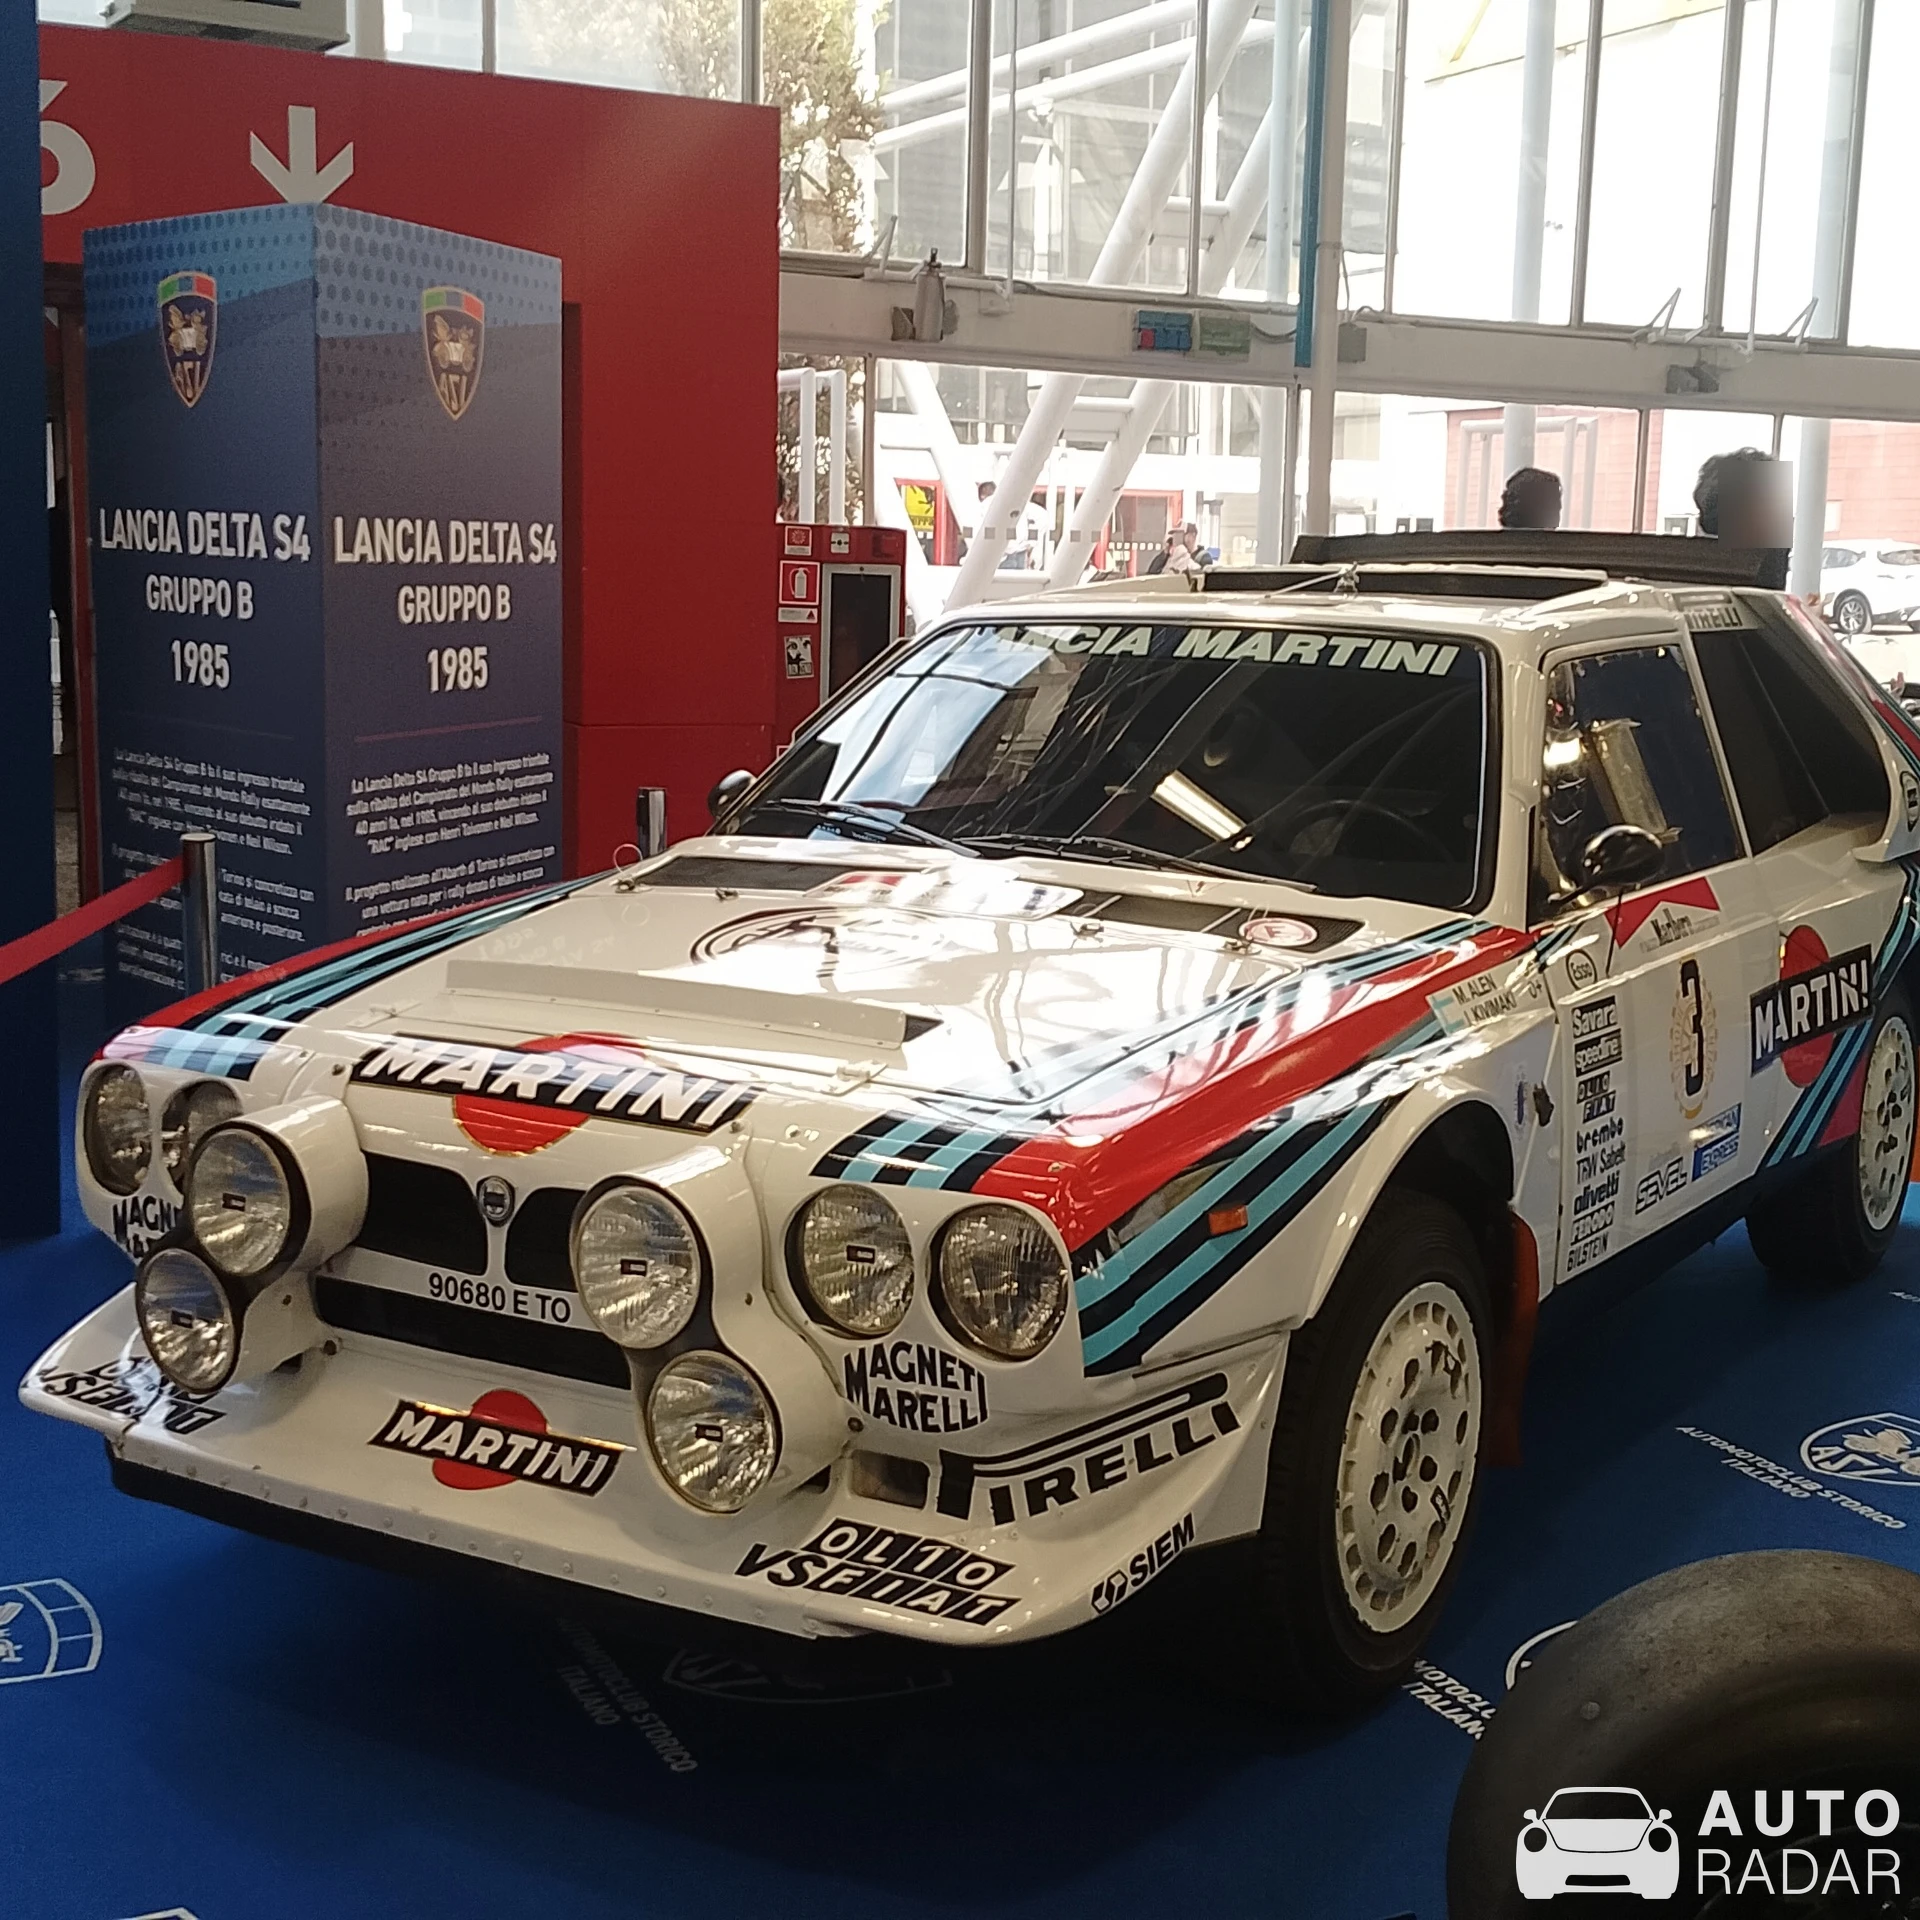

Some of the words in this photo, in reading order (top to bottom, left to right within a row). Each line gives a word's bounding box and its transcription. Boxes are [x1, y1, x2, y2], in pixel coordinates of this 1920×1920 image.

[100, 508, 183, 554] LANCIA
[187, 511, 268, 559] DELTA
[274, 514, 311, 562] S4
[334, 516, 443, 564] LANCIA
[449, 520, 524, 564] DELTA
[530, 522, 557, 564] S4
[146, 574, 232, 618] GRUPPO
[237, 581, 254, 620] B
[398, 584, 491, 624] GRUPPO
[495, 584, 512, 621] B
[172, 639, 231, 688] 1985
[427, 646, 489, 693] 1985
[985, 626, 1153, 657] ANCIA
[1173, 628, 1460, 677] MARTINI
[1573, 1004, 1617, 1037] Savara
[1681, 958, 1704, 1097] 3
[1755, 959, 1869, 1060] MARTINI
[361, 1037, 751, 1126] MARTINI
[1578, 1074, 1609, 1100] OLIO
[1584, 1093, 1616, 1120] FIAT
[1576, 1116, 1624, 1154] brembo
[1574, 1170, 1620, 1216] olivetti
[1635, 1156, 1688, 1215] SEVEL
[113, 1195, 177, 1238] MAGN
[1572, 1203, 1614, 1242] FERODO
[1566, 1231, 1609, 1272] BILSTEIN
[429, 1272, 506, 1311] 90680
[514, 1289, 529, 1315] E
[536, 1293, 571, 1323] TO
[844, 1341, 988, 1398] MAGNETI
[844, 1382, 988, 1433] MARELLI
[385, 1407, 610, 1490] MARTINI
[935, 1372, 1241, 1526] PIRELLI
[1675, 1426, 1824, 1491] AUTOMOTOCLUB
[1816, 1488, 1907, 1530] STORICO
[1721, 1458, 1812, 1499] ITALIANO
[1130, 1511, 1195, 1588] SIEM
[1402, 1682, 1486, 1740] ITALIAN
